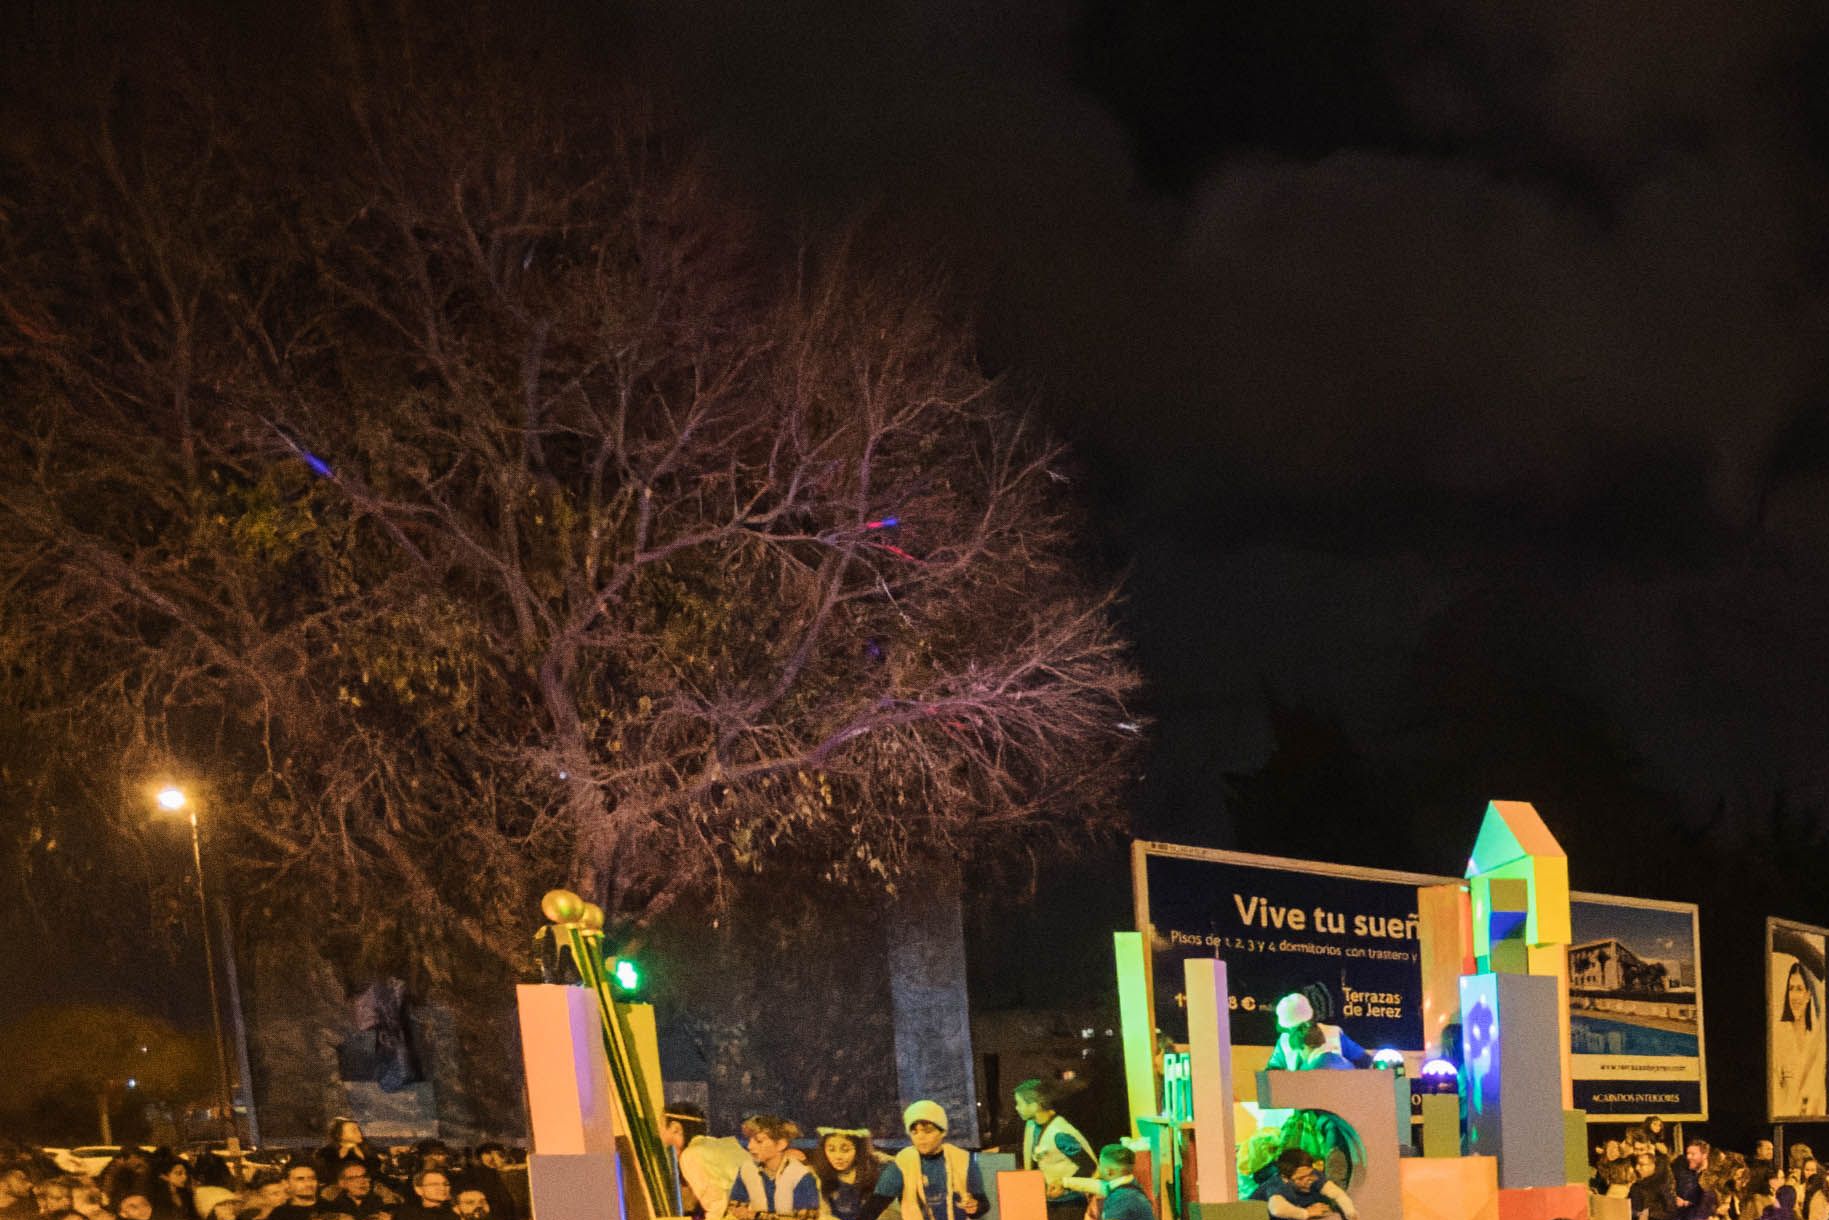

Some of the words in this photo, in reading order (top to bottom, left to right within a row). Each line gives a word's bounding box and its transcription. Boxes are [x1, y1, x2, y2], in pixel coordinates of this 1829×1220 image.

[1234, 894, 1305, 929] Vive
[1313, 907, 1345, 933] tu
[1354, 913, 1420, 939] sueñ
[1171, 929, 1202, 945] Pisos
[1205, 933, 1220, 946] de
[1248, 939, 1255, 952] 3
[1257, 941, 1265, 952] y
[1279, 940, 1341, 956] dormitorios
[1345, 947, 1366, 957] con
[1368, 948, 1409, 961] trastero
[1342, 987, 1401, 1003] Terrazas
[1343, 1003, 1362, 1016] de
[1366, 1003, 1401, 1018] Jerez
